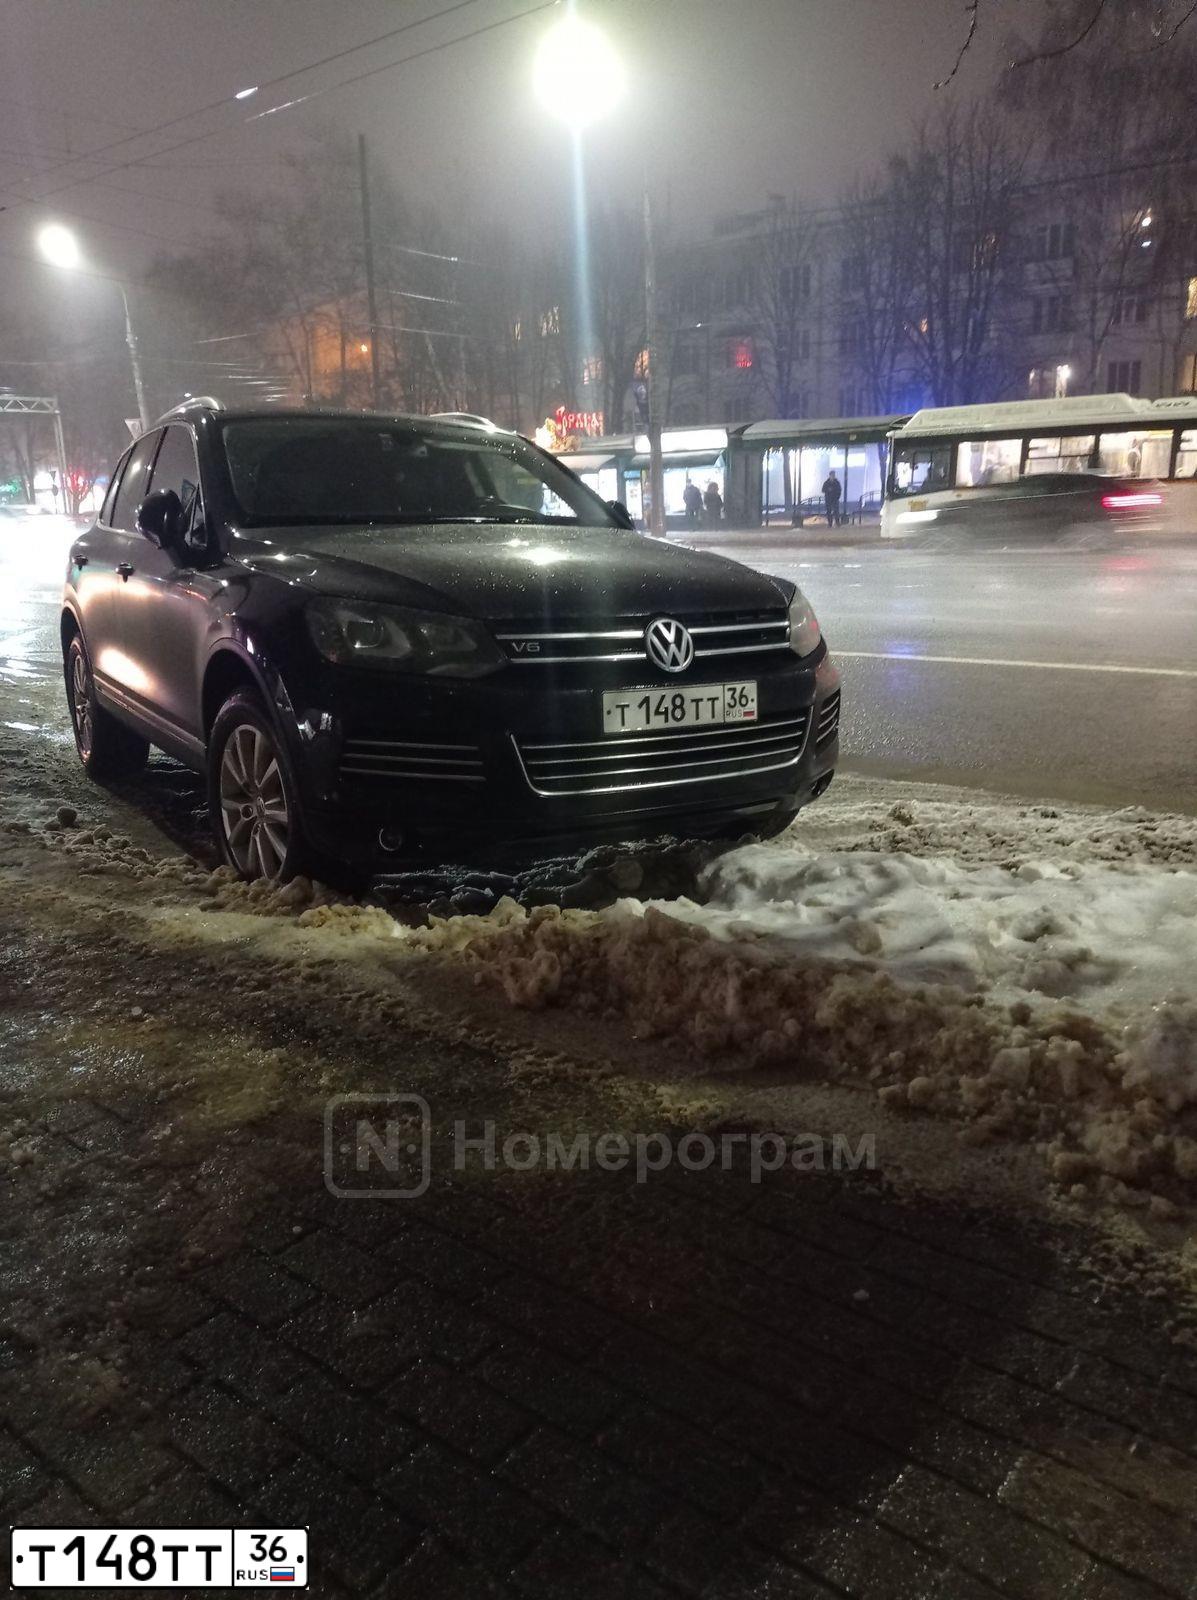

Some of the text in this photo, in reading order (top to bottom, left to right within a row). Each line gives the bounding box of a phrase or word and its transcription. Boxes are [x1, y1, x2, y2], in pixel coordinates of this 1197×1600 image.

[511, 641, 541, 653] V6
[726, 686, 749, 709] 36
[725, 708, 743, 718] RUS
